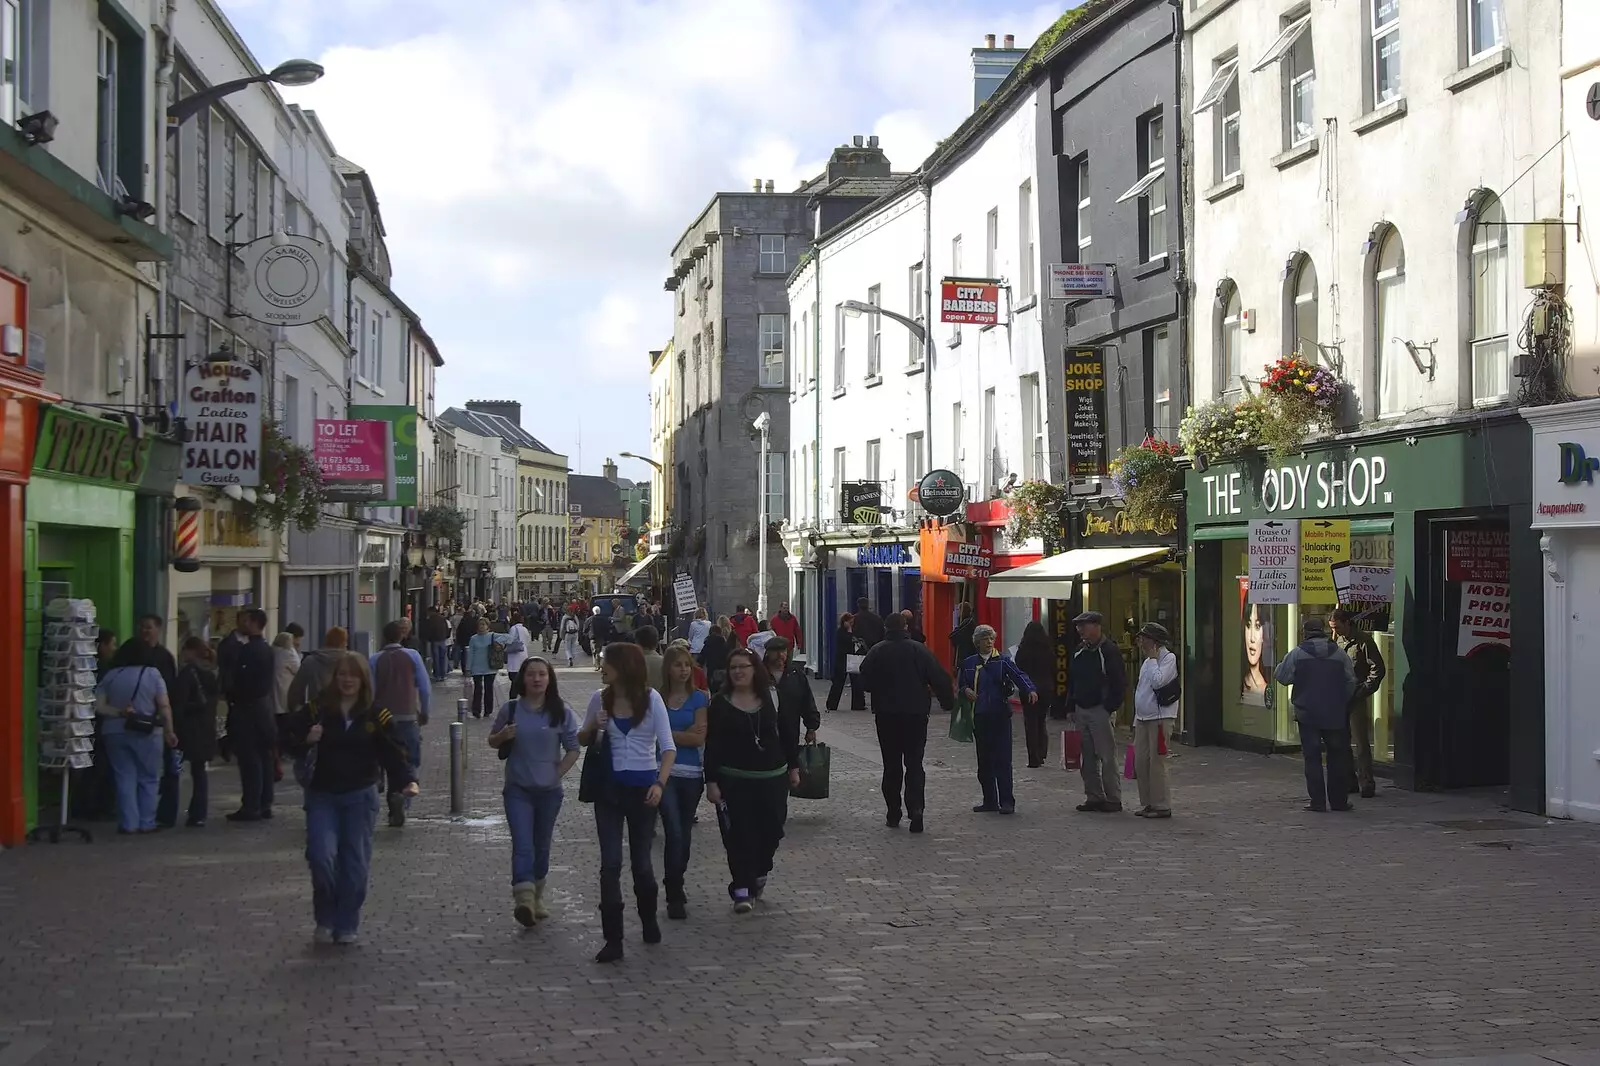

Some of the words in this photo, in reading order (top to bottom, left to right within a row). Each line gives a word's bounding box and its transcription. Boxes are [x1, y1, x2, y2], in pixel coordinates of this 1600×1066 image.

[275, 248, 311, 265] SAMUEL
[957, 287, 984, 299] CITY
[943, 299, 997, 313] BARBERS
[198, 362, 252, 380] House
[1066, 363, 1101, 374] JOKE
[1065, 379, 1103, 390] SHOP
[190, 386, 256, 404] Grafton
[197, 407, 249, 418] Ladies
[195, 421, 248, 443] HAIR
[318, 423, 336, 436] TO
[339, 424, 358, 436] LET
[45, 413, 150, 484] TRIBES
[1078, 449, 1096, 457] Nights
[186, 447, 257, 470] SALON
[1558, 442, 1600, 485] Dr
[201, 471, 241, 484] Gents
[1203, 473, 1242, 516] THE
[1257, 464, 1311, 512] ODY
[1317, 456, 1386, 508] SHOP
[853, 491, 881, 503] GUINNESS
[1537, 501, 1586, 516] Acupuncture
[1255, 528, 1280, 536] House
[1281, 528, 1292, 536] Of
[958, 544, 981, 555] CITY
[1250, 545, 1296, 555] BARBERS
[1304, 542, 1341, 553] Unlocking
[857, 544, 905, 565] GARAVANS
[947, 553, 991, 567] BARBERS
[1304, 555, 1333, 565] Repairs
[1259, 556, 1287, 566] SHOP
[970, 569, 990, 578] €10
[1259, 570, 1287, 580] Ladies
[1349, 566, 1390, 574] ATTOOS
[1250, 581, 1270, 590] Hair
[1271, 581, 1296, 590] Salon
[1056, 644, 1067, 696] SHOP
